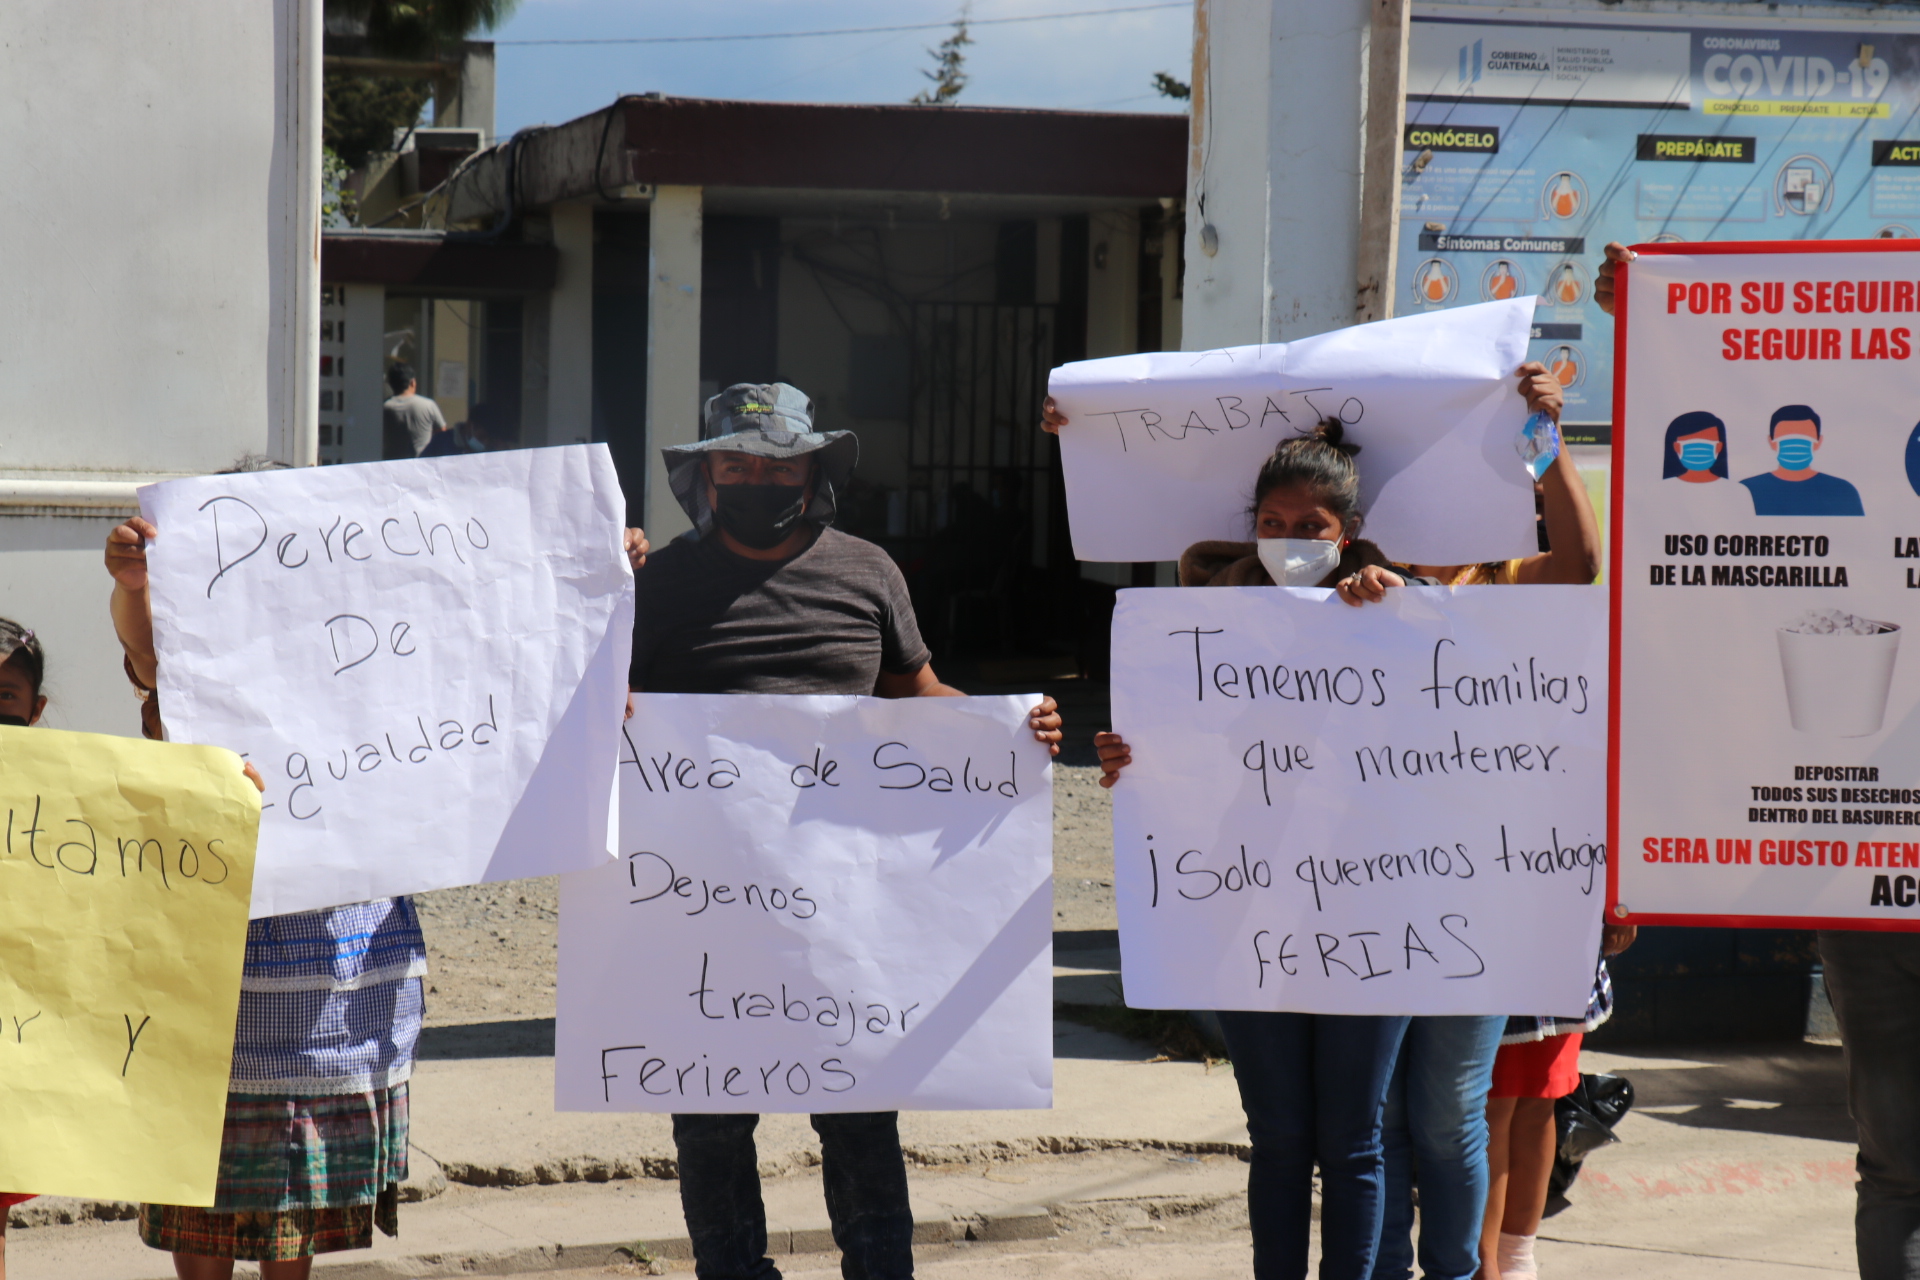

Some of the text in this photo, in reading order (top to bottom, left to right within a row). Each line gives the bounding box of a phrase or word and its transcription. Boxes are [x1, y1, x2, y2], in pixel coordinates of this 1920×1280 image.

[1491, 51, 1537, 61] GOBIERNO
[1556, 56, 1581, 64] SALUD
[1557, 47, 1610, 56] MINISTERIO DE
[1703, 37, 1780, 51] CORONAVIRUS
[1487, 60, 1550, 72] GUATEMALA
[1563, 65, 1605, 73] ASISTENCIA
[1703, 53, 1890, 98] COVID-19
[1409, 129, 1494, 148] CONÓCELO
[1656, 139, 1742, 158] PREPÁRATE
[1890, 146, 1920, 160] ACT
[1437, 236, 1566, 251] Síntomas Comunes
[1667, 280, 1920, 315] POR SU SEGUIR
[1722, 327, 1911, 361] SEGUIR LAS
[1084, 387, 1364, 452] TRABAJO
[198, 495, 490, 599] Derecho
[1664, 534, 1829, 557] USO CORRECTO
[1650, 565, 1849, 588] DE LA MASCARILLA
[324, 614, 416, 676] De
[1168, 626, 1589, 714] Tenemos familias
[241, 693, 499, 820] gualdad
[790, 747, 841, 788] de
[873, 742, 1019, 798] Salud
[1242, 740, 1315, 807] que
[1794, 766, 1879, 782] DEPOSITAR
[1751, 786, 1920, 804] TODOS SUS DESECHOS
[1748, 807, 1808, 823] DENTRO
[1812, 809, 1838, 824] DEL
[1642, 836, 1920, 868] SERA UN GUSTO ATEN
[629, 851, 818, 920] Dejenos
[1295, 842, 1476, 912] queremos
[1870, 874, 1920, 908] AC
[1253, 914, 1485, 989] FERIAS
[688, 952, 920, 1047] trabajar
[600, 1045, 857, 1103] Ferieros
